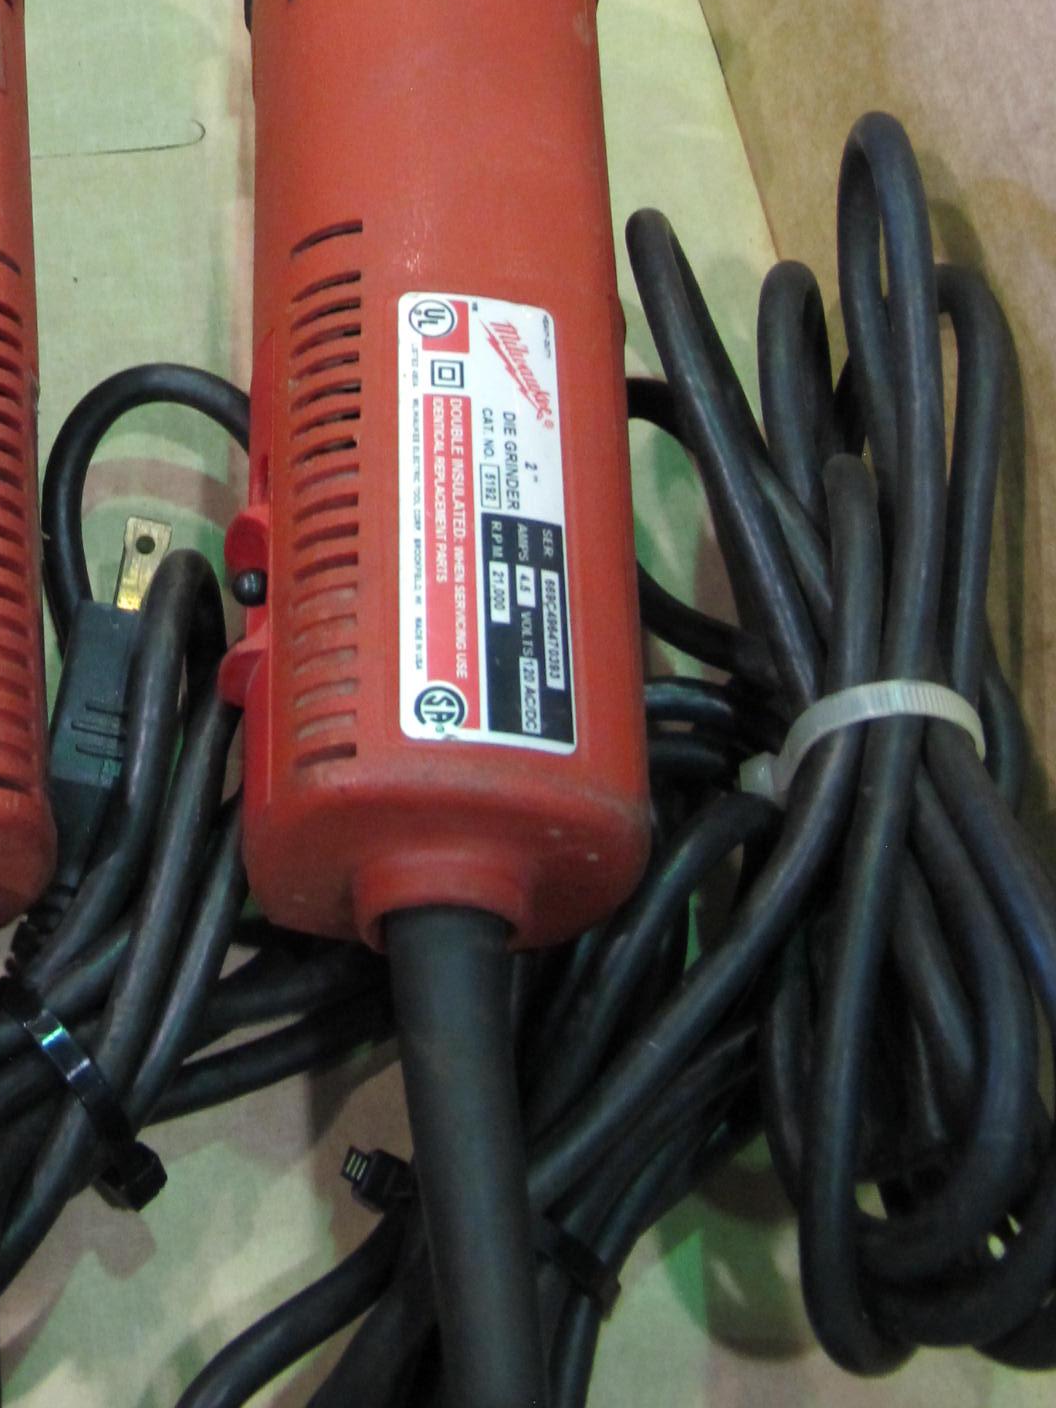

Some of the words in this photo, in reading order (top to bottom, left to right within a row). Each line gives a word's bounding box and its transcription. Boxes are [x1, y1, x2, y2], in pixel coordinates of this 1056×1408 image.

[432, 396, 445, 453] IDENTICAL
[449, 397, 463, 453] DOUBLE
[482, 407, 494, 433] CAT.
[502, 411, 518, 436] DIE
[504, 441, 521, 511] GRINDER
[433, 456, 447, 540] REPLACEMENT
[516, 522, 530, 561] AMPS
[435, 543, 448, 583] PARTS
[454, 545, 466, 581] WHEN
[519, 573, 531, 592] 4.5
[492, 569, 507, 611] 21,000
[454, 585, 467, 650] SERVICING
[520, 611, 535, 657] VOLTS
[456, 653, 468, 678] USE
[522, 660, 536, 682] 120
[523, 685, 539, 731] AC/DC
